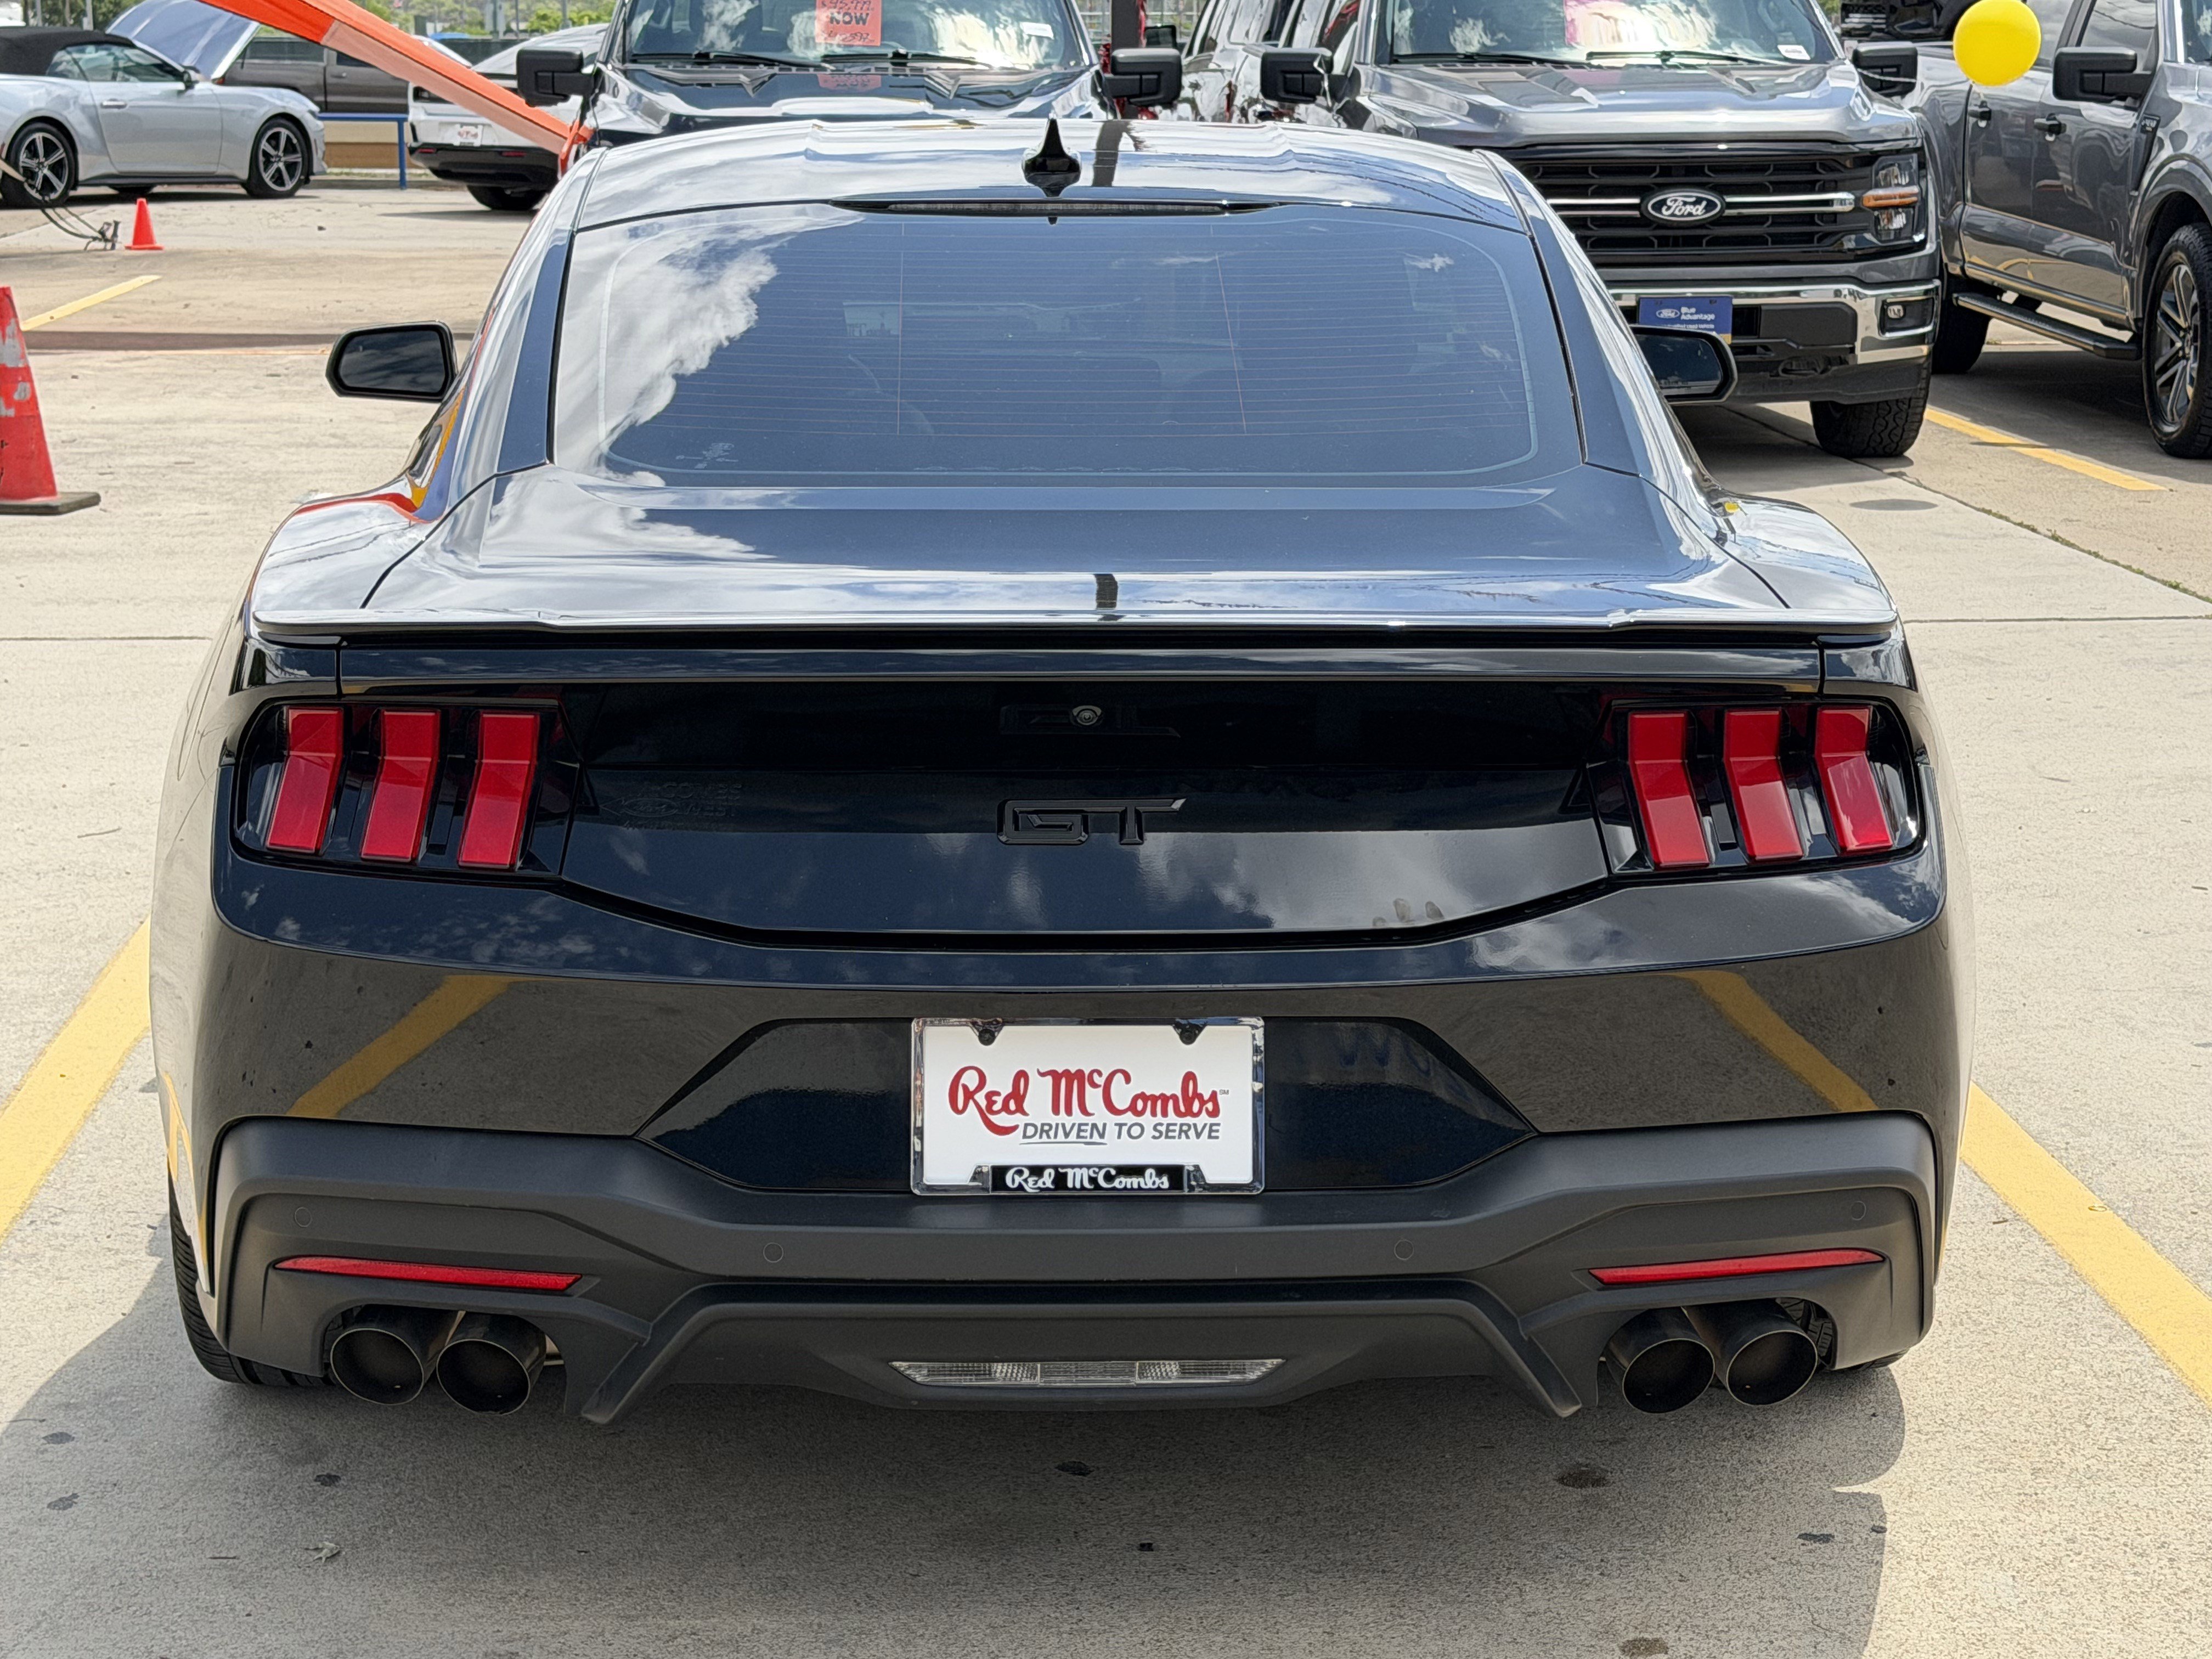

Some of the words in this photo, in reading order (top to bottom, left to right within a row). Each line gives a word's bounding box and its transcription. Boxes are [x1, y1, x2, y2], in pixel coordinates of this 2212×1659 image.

[830, 12, 870, 26] NOW
[1661, 196, 1707, 216] Ford
[997, 798, 1187, 845] GT
[948, 1065, 1030, 1136] Red
[1037, 1068, 1221, 1119] McCombs
[1023, 1122, 1107, 1140] DRIVEN
[1114, 1122, 1146, 1140] TO
[1150, 1122, 1221, 1140] SERVE
[1005, 1166, 1055, 1193] Red
[1058, 1166, 1169, 1189] McCombs
